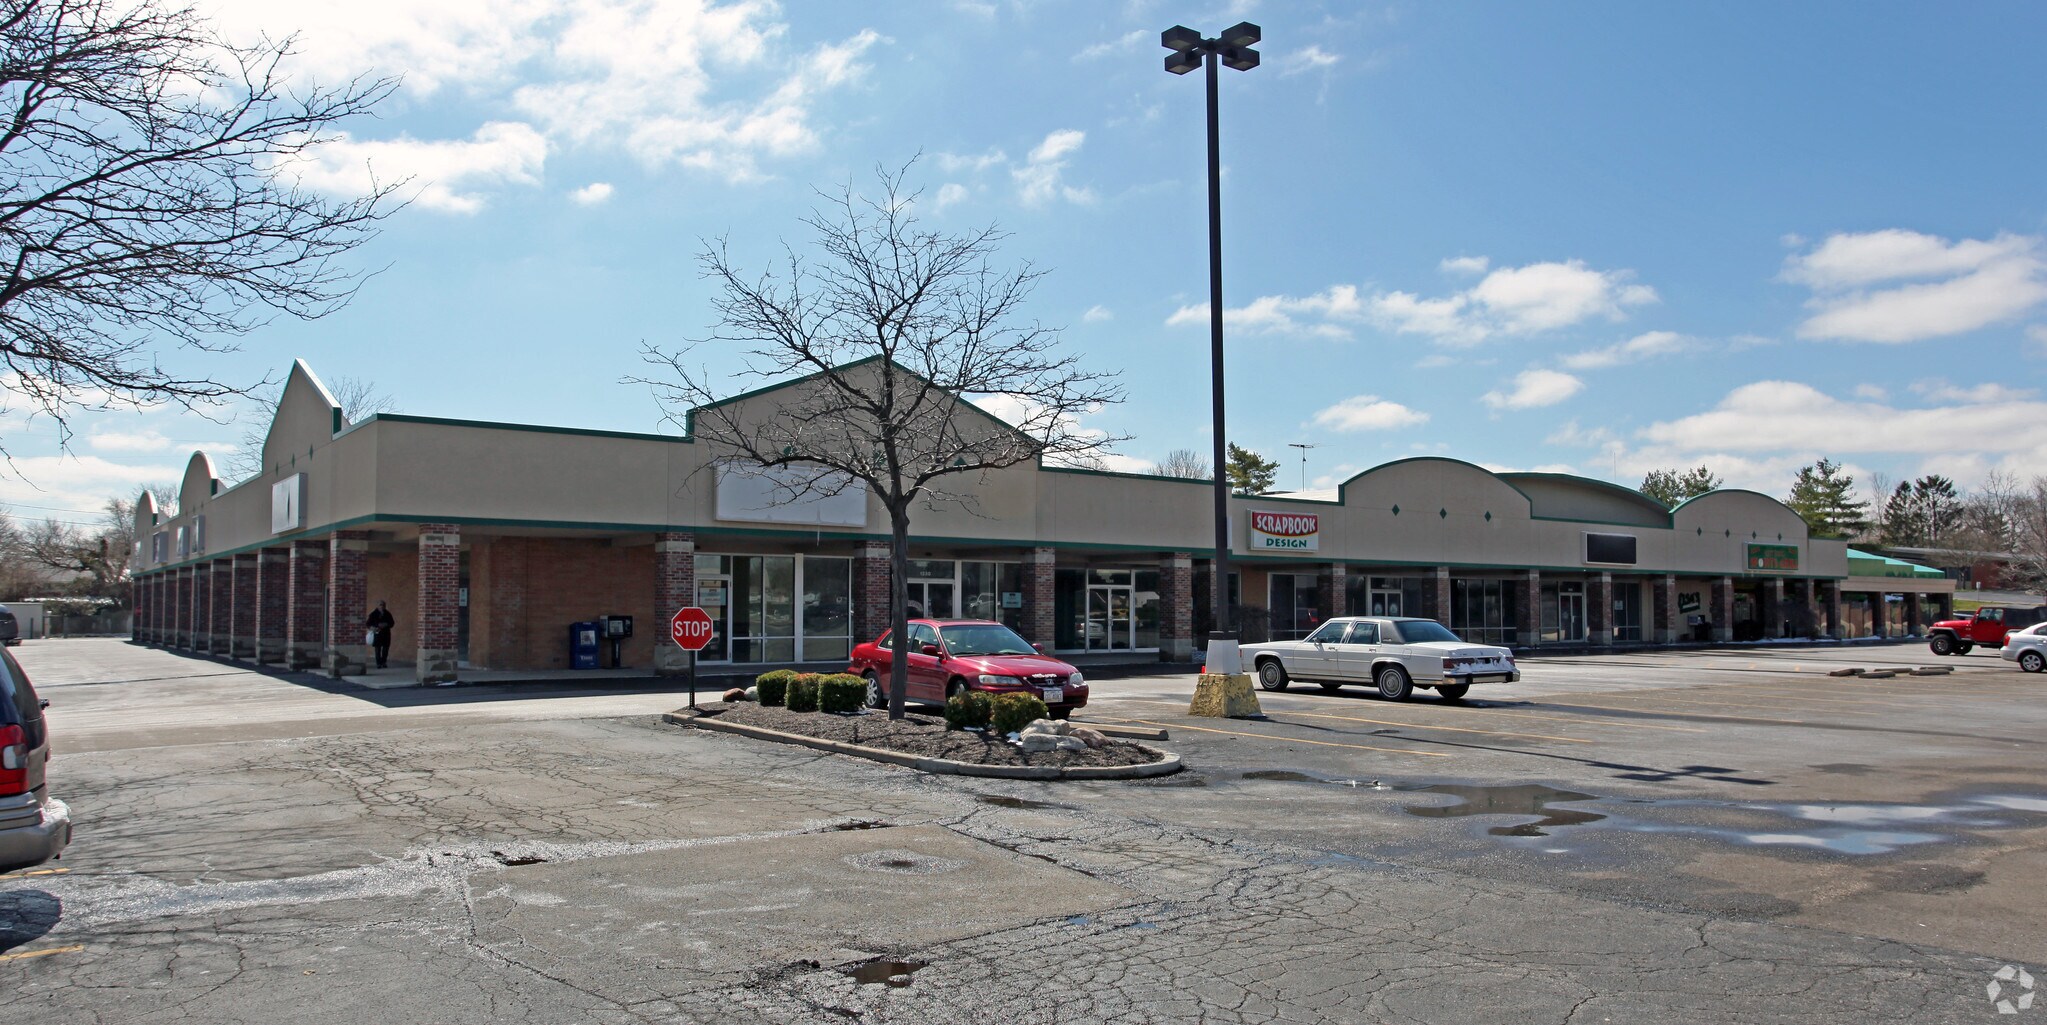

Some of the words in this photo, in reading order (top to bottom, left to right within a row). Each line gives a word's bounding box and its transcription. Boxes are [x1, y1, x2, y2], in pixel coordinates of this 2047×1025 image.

[1257, 515, 1316, 534] SCRAPBOOK
[1266, 538, 1307, 548] DESIGN
[674, 620, 710, 637] STOP
